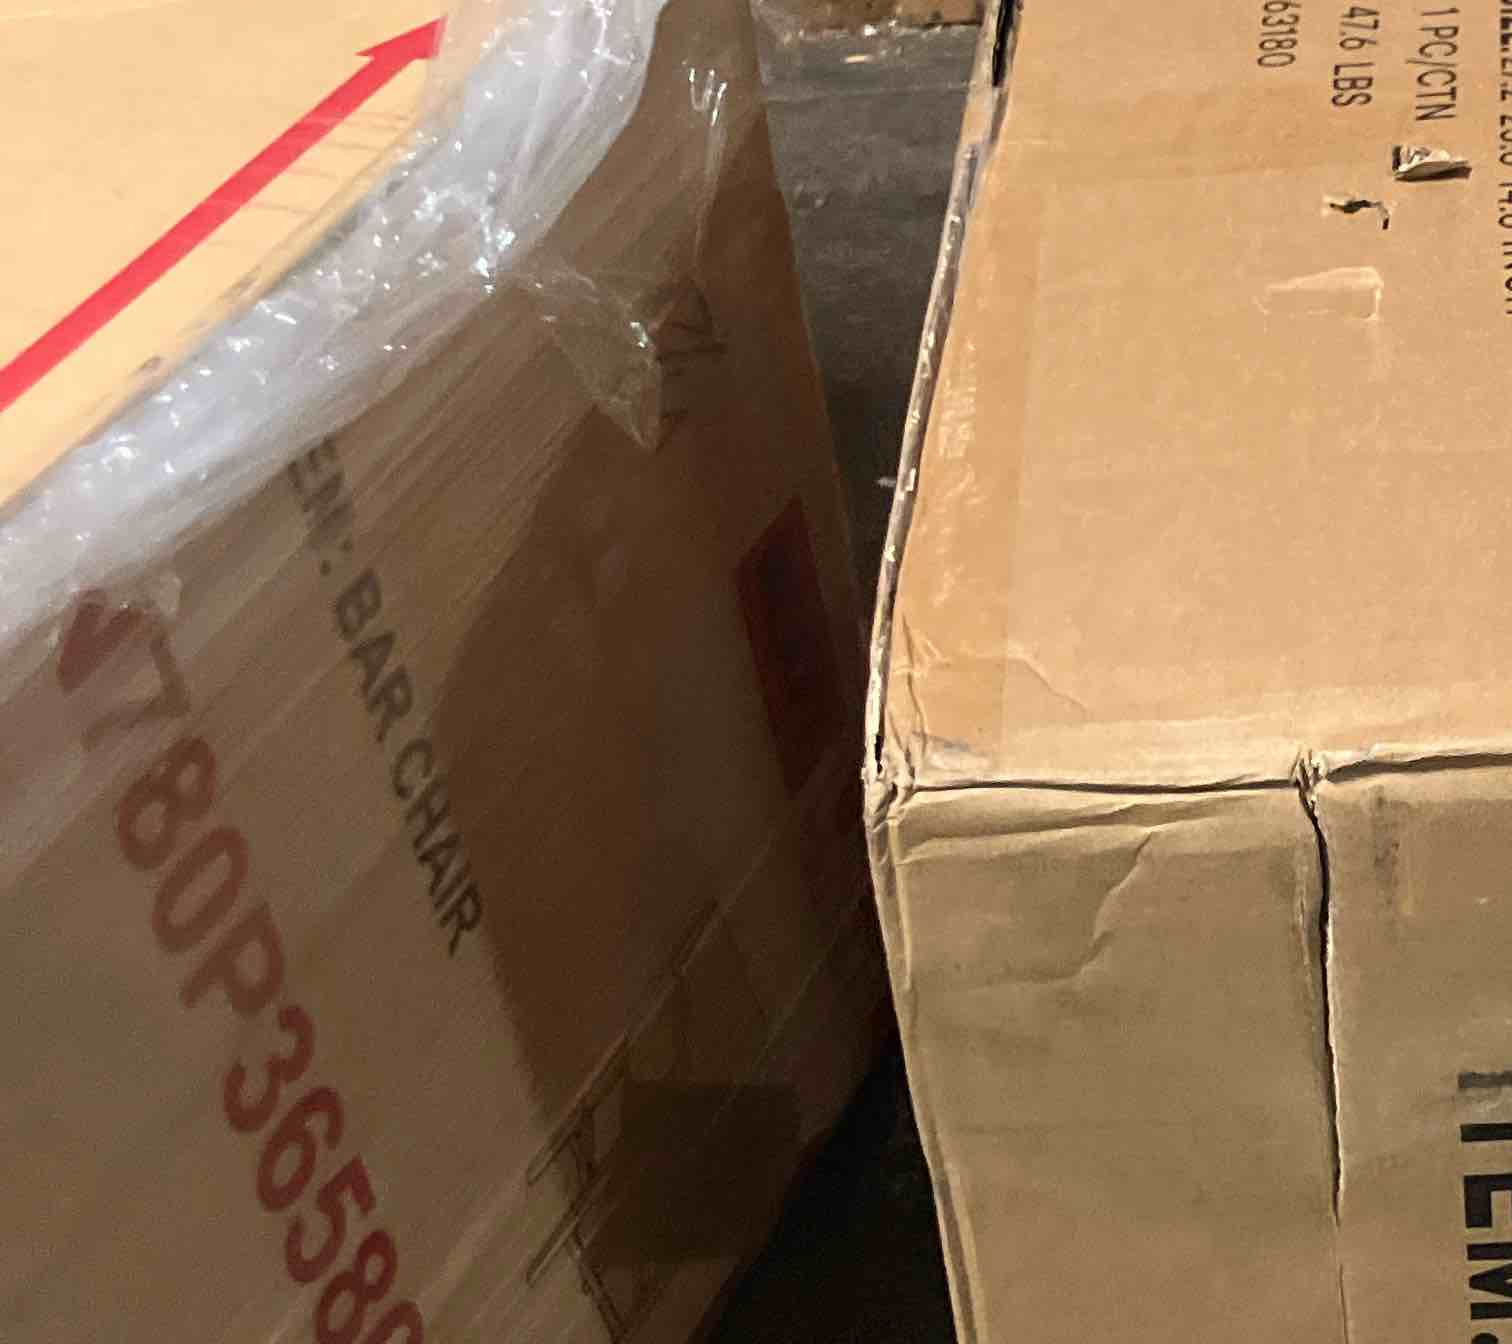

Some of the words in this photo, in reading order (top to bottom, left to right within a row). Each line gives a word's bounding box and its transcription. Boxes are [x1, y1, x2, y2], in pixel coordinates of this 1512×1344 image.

[1257, 0, 1302, 68] 63180
[1339, 6, 1380, 51] 47.6
[1331, 62, 1375, 107] LBS
[1405, 26, 1459, 122] PC/CTN
[335, 568, 413, 742] BAR
[391, 737, 484, 957] CHAIR
